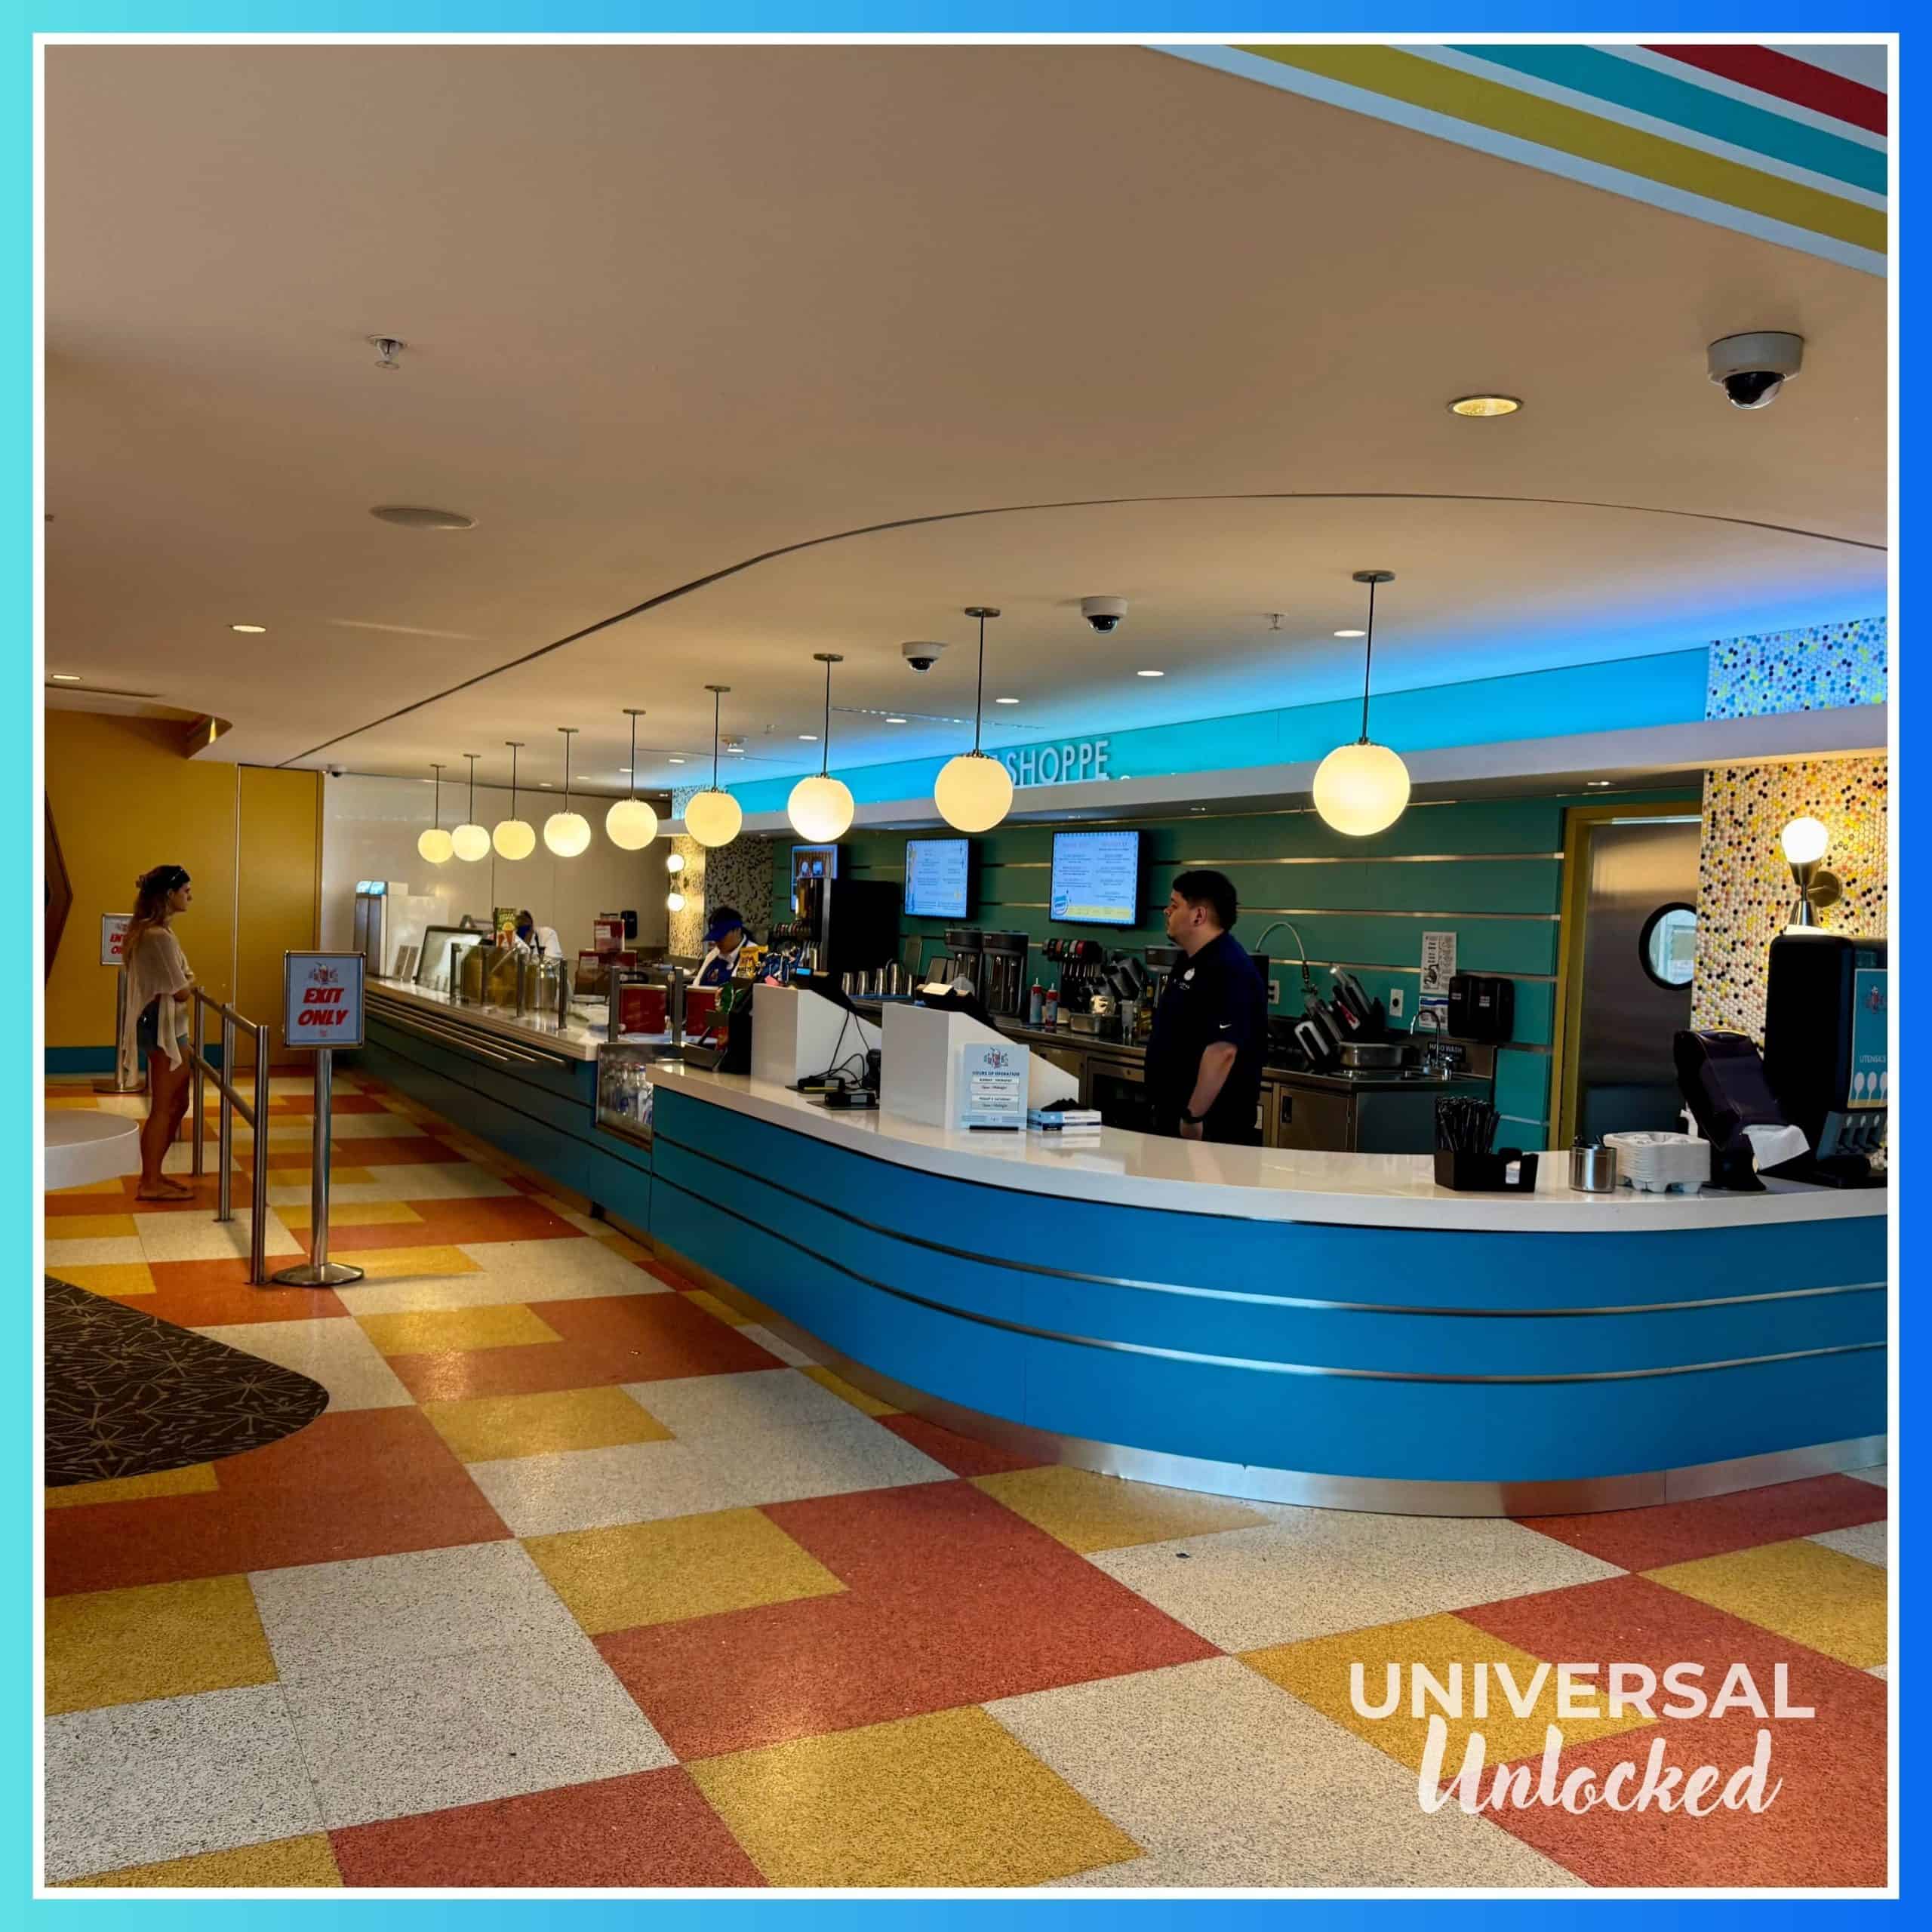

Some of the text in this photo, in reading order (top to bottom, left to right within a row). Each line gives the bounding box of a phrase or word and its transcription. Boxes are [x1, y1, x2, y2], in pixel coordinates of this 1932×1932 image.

[1006, 740, 1109, 787] SHOPPE
[303, 987, 345, 1004] EXIT
[297, 1009, 349, 1027] ONLY
